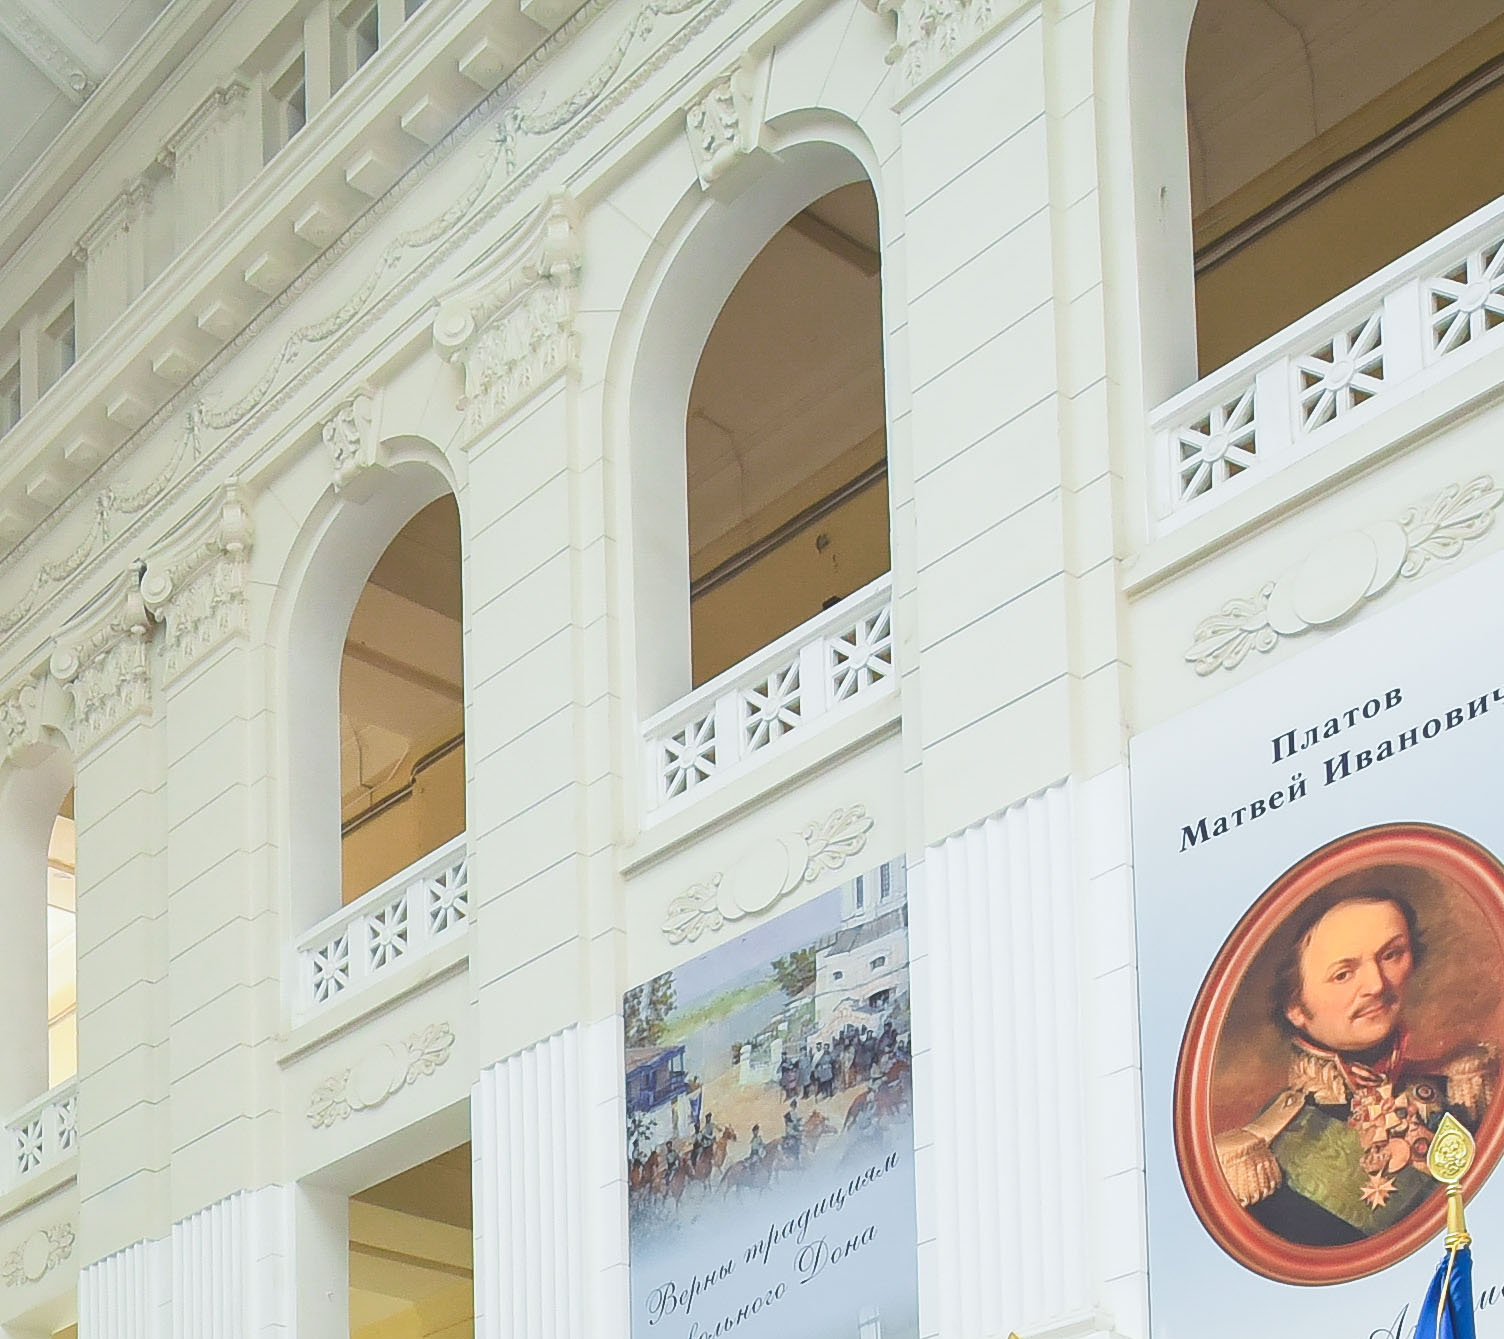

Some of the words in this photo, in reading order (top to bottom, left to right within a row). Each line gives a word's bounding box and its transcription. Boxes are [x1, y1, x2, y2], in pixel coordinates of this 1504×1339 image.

[1270, 686, 1404, 765] Платов
[1177, 771, 1308, 854] Матвей
[644, 1259, 737, 1327] Верны
[743, 1151, 901, 1266] традициям
[793, 1225, 879, 1286] Дона
